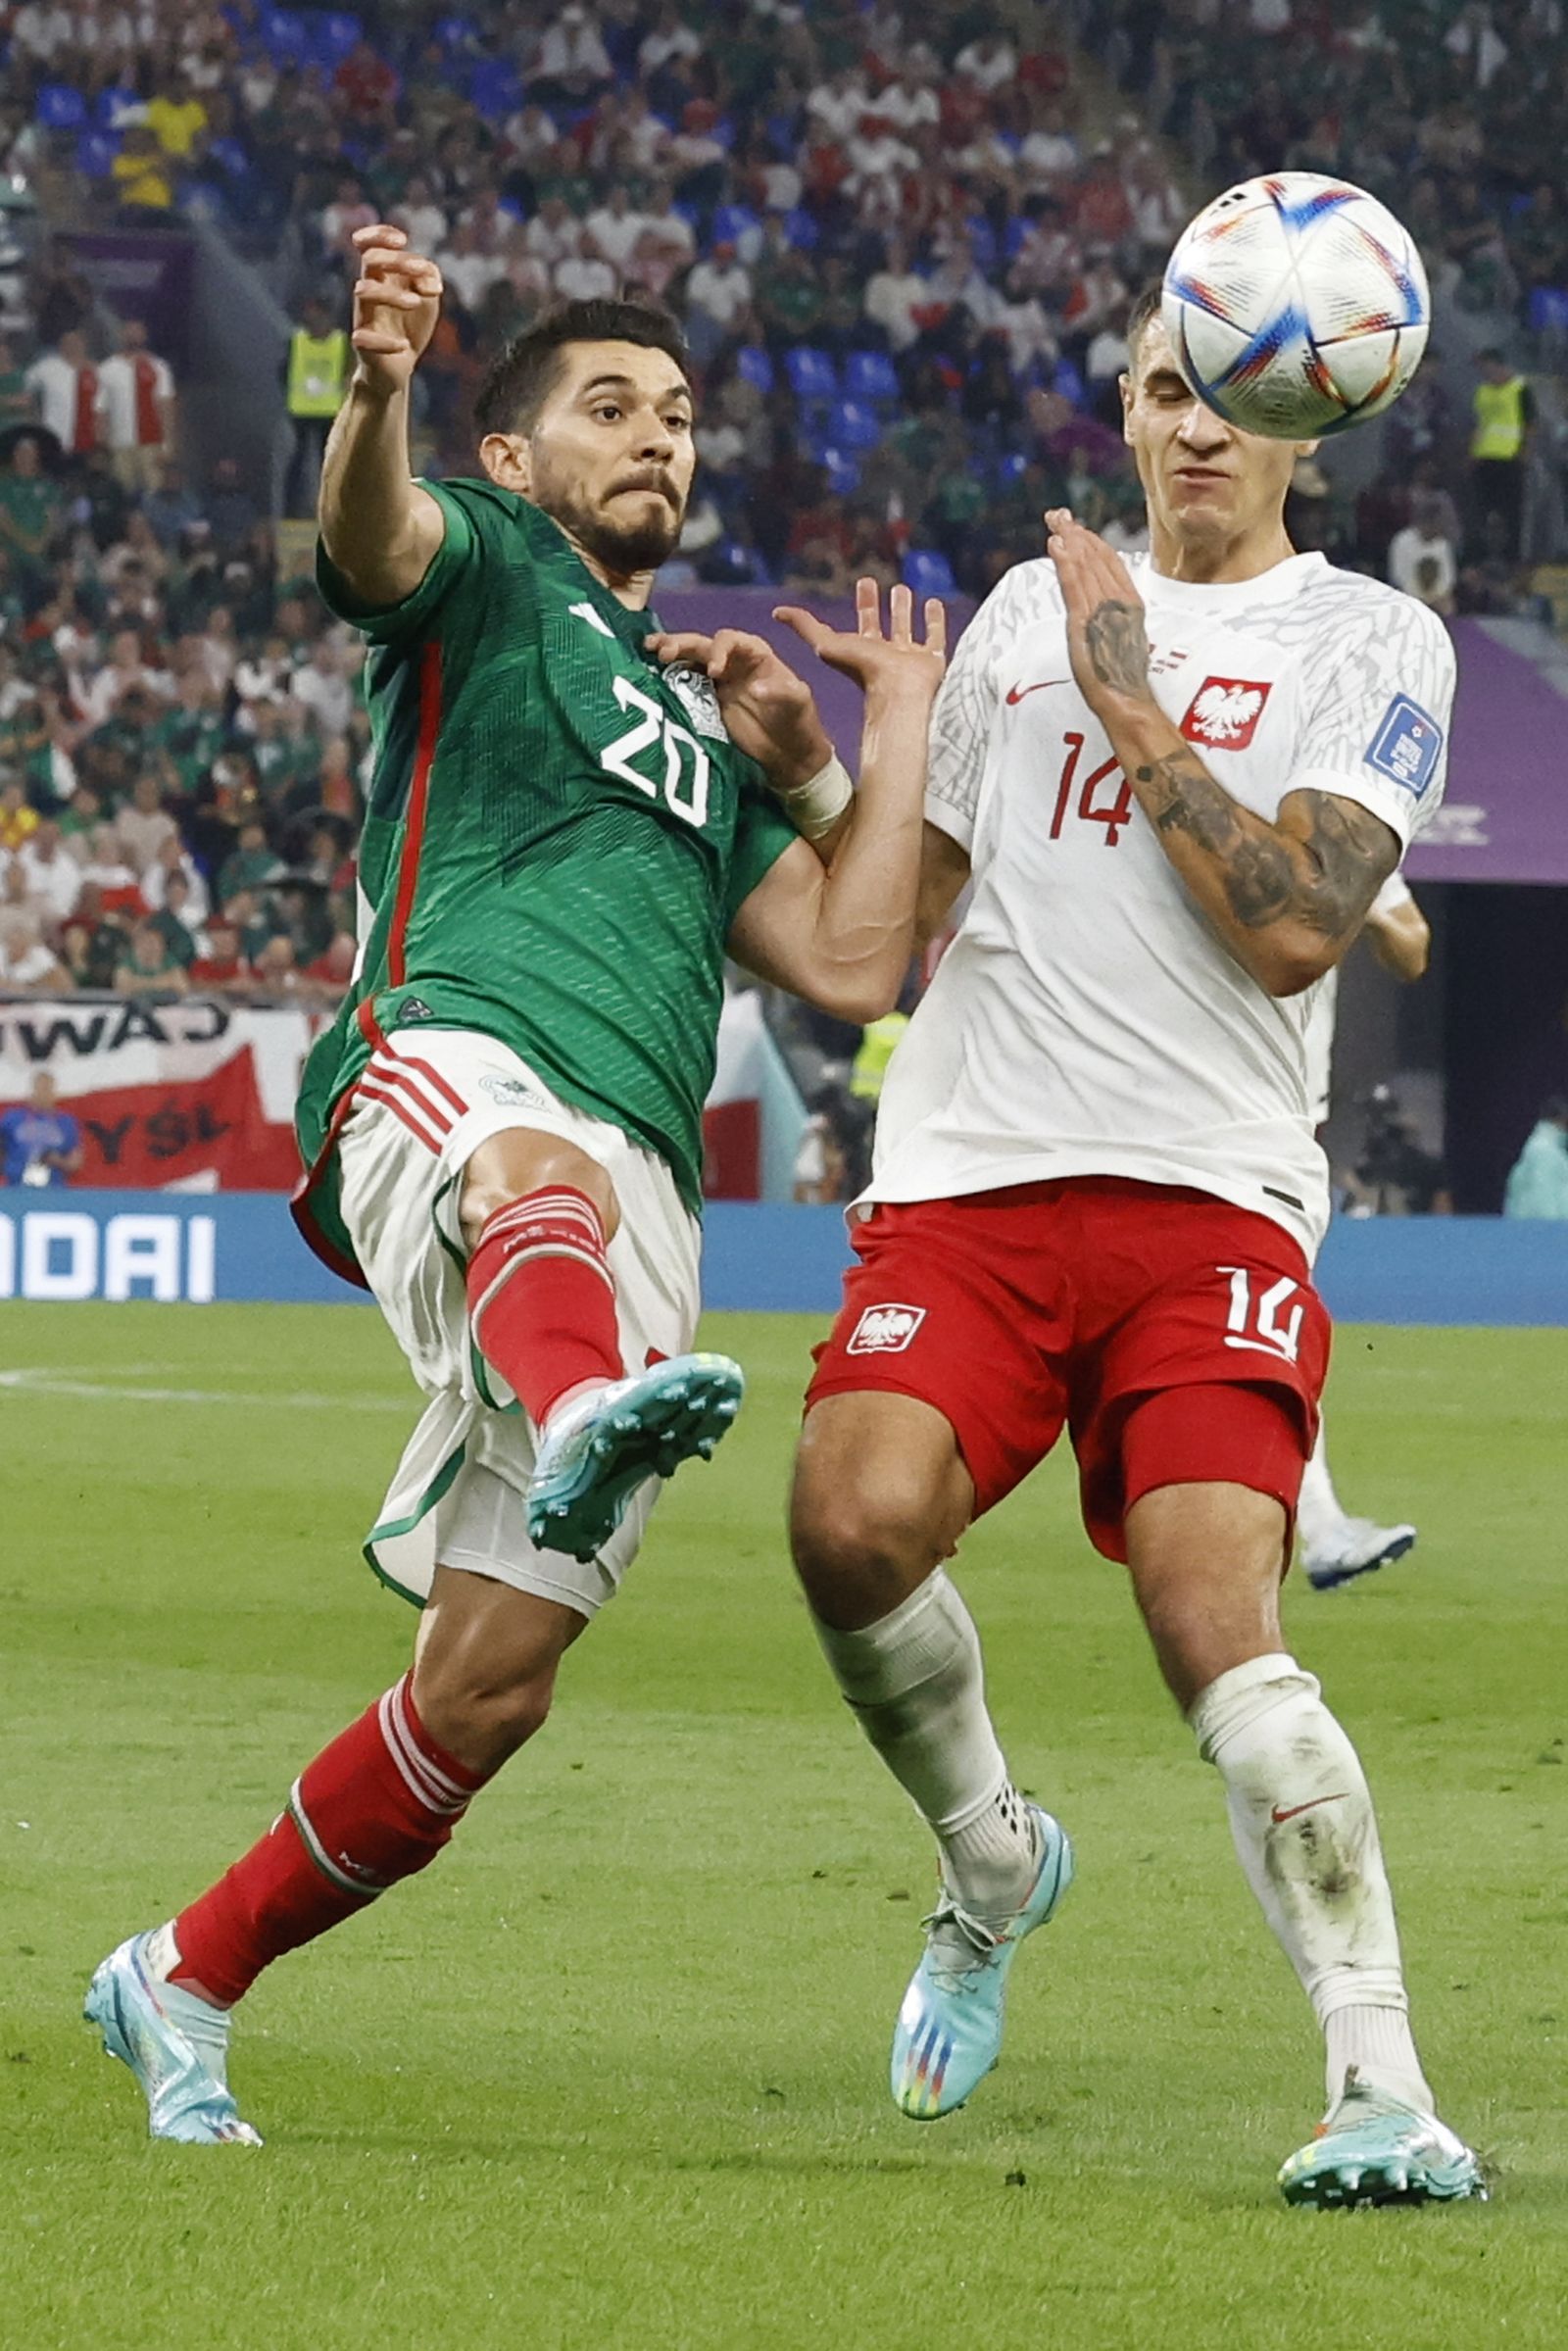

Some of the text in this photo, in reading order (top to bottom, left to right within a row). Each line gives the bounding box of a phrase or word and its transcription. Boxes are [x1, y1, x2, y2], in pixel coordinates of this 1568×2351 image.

[600, 675, 710, 827] 20
[1050, 732, 1133, 846] 14
[0, 1211, 215, 1302] DAI
[1216, 1267, 1304, 1367] 14
